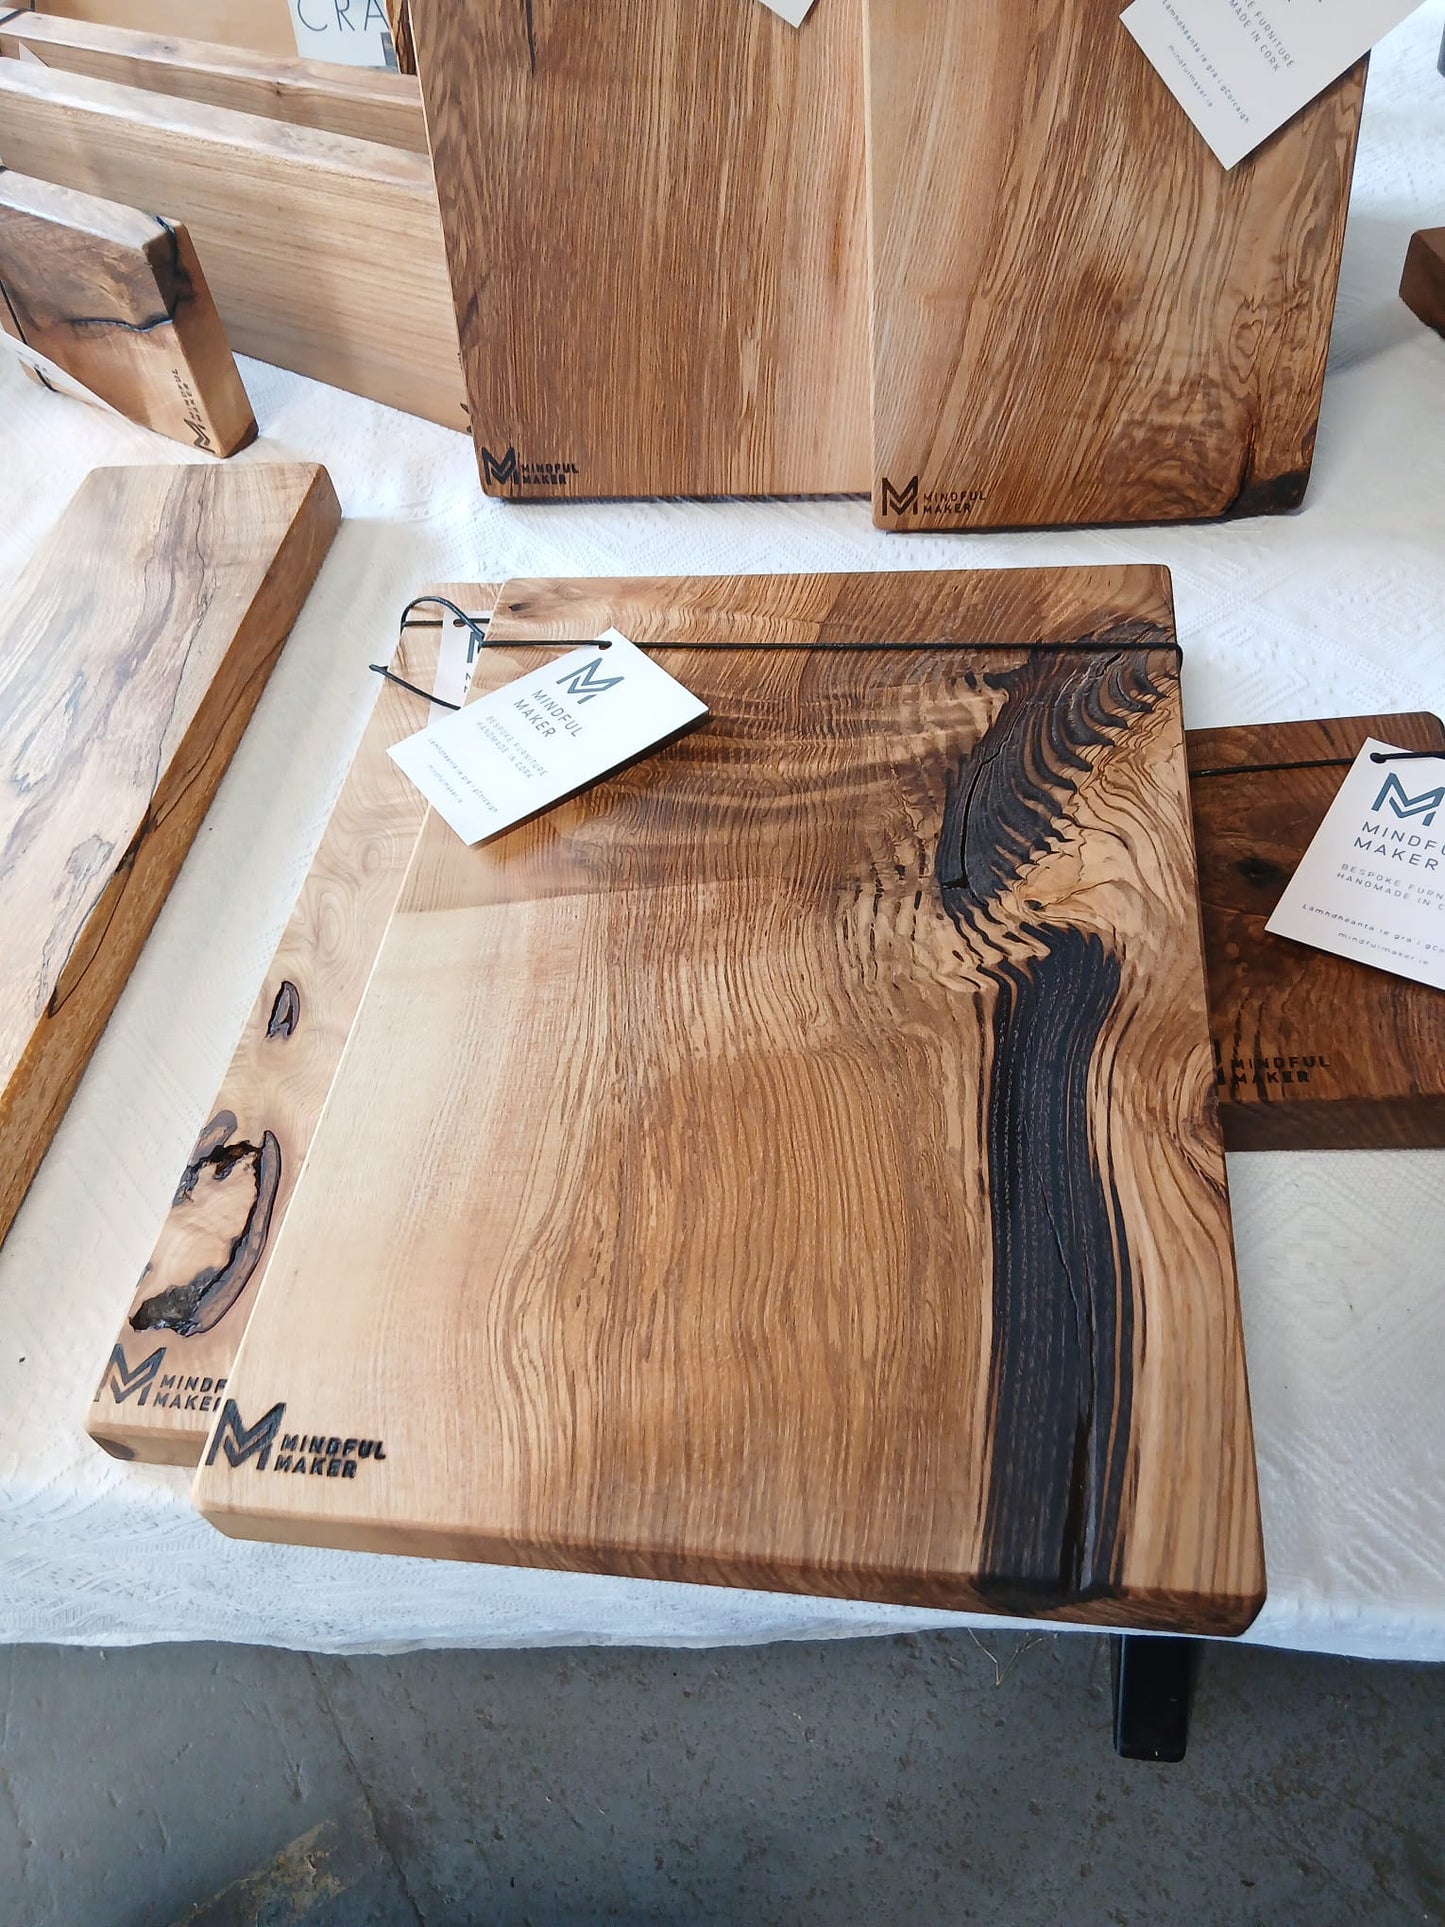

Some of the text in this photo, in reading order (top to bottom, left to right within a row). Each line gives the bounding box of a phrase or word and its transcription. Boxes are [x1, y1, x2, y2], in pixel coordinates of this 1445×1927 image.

[1250, 31, 1261, 43] IN
[1260, 45, 1281, 72] CORK
[1254, 11, 1295, 68] FURNITURE
[521, 463, 579, 474] MINDFUL
[522, 474, 567, 485] MAKER
[923, 491, 987, 502] MINDFUL
[923, 503, 972, 514] MAKER
[513, 698, 556, 738] MAKER
[531, 689, 583, 738] MINDFUL
[514, 742, 548, 777] FURNITURE
[515, 761, 534, 779] CORK
[1354, 837, 1439, 871] MAKER
[1341, 863, 1402, 887] BESPOKE
[1337, 872, 1410, 900] HANDMADE
[1417, 897, 1431, 907] IN
[1232, 1056, 1330, 1069] MINDFUL
[1232, 1070, 1310, 1084] MAKER
[280, 1433, 386, 1460] MINDFUL
[274, 1454, 358, 1479] MAKER
